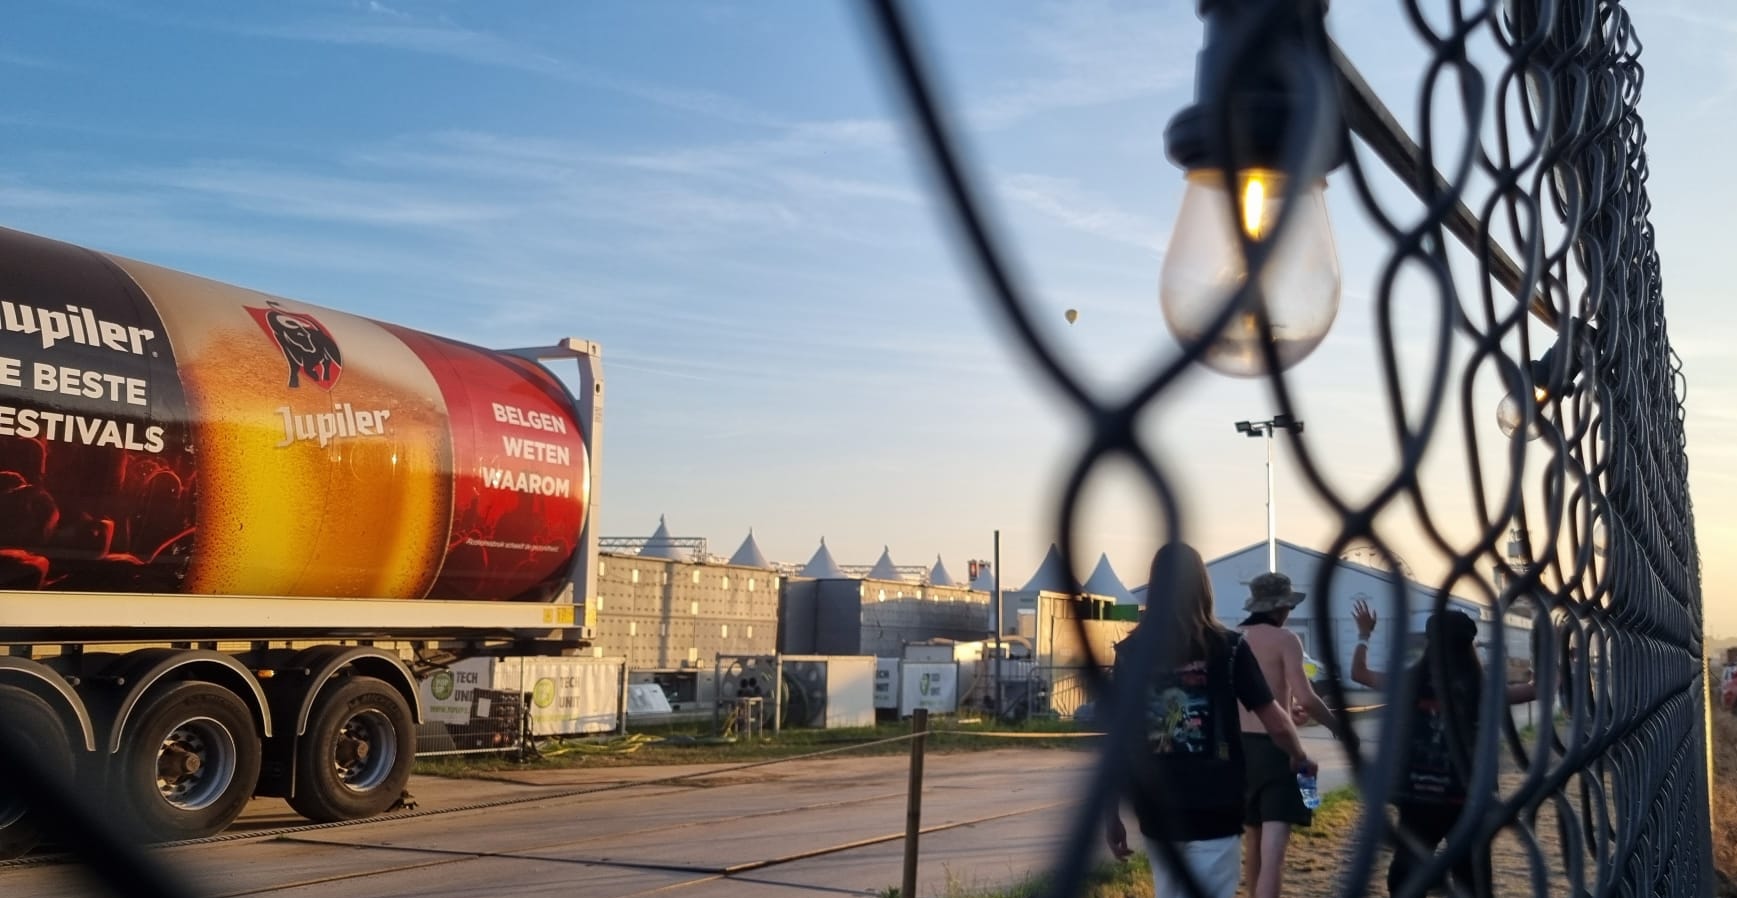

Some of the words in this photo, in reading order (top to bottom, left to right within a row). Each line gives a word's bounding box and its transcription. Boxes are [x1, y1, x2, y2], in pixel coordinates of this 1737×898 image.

[0, 301, 155, 355] upiler
[33, 362, 147, 406] BESTE
[275, 403, 390, 449] Jupiler
[492, 402, 567, 434] BELGEN
[502, 435, 570, 466] WETEN
[482, 466, 570, 498] WAAROM
[456, 671, 478, 684] TECH
[455, 689, 475, 702] UNI
